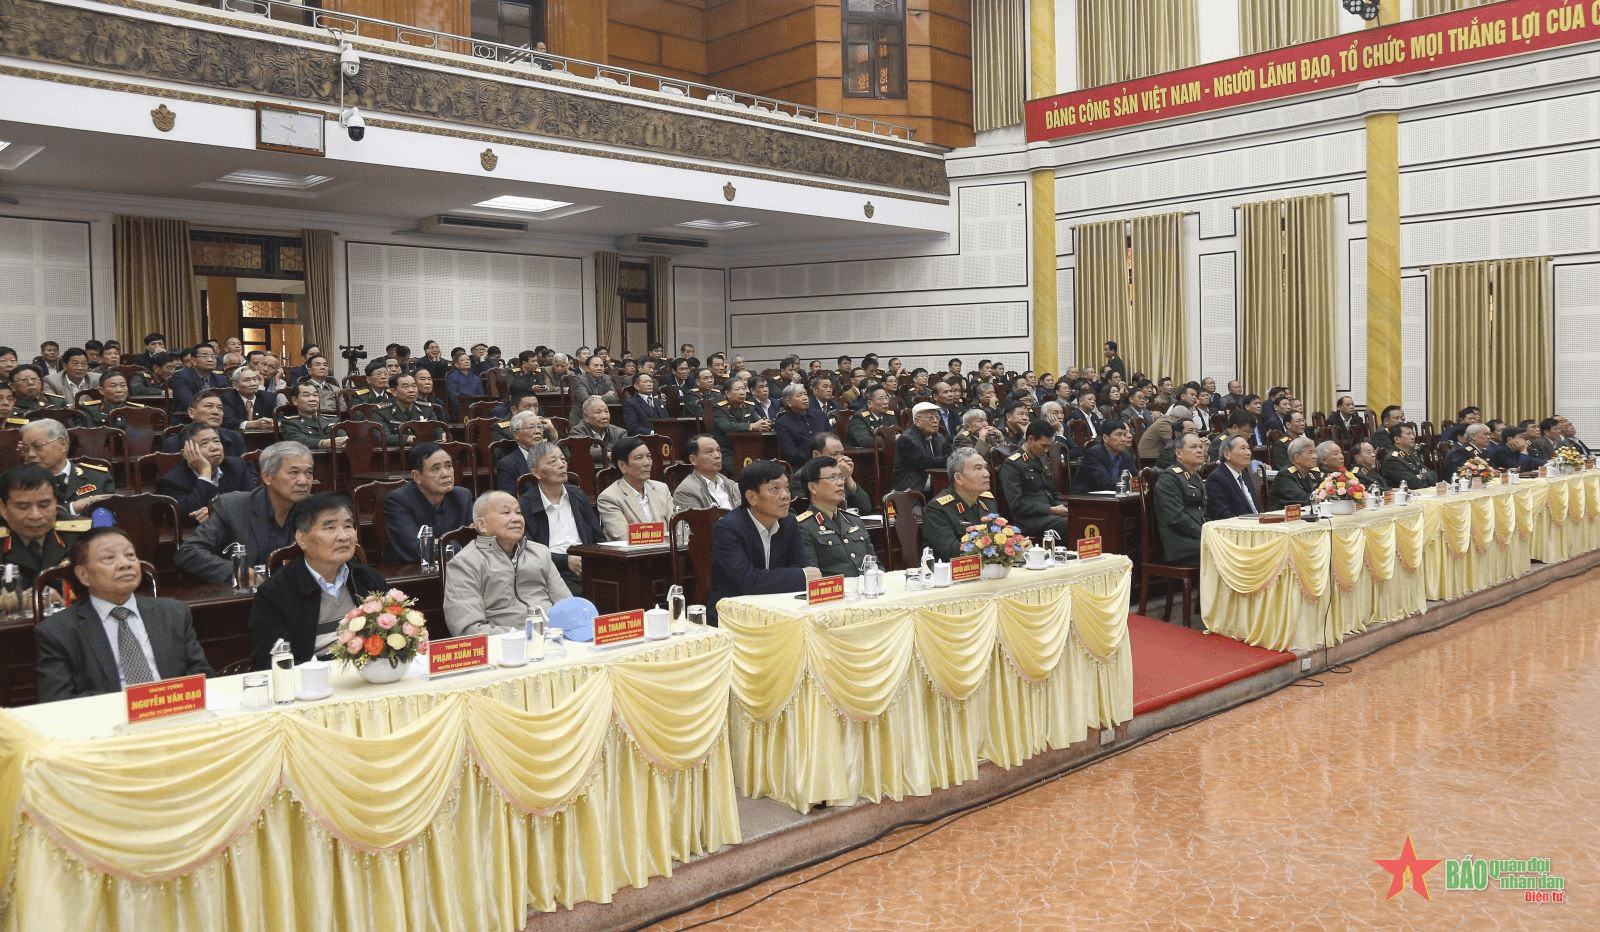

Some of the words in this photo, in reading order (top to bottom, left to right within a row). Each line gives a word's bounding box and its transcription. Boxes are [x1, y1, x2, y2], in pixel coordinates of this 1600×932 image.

[1045, 101, 1076, 129] ĐẢNG
[1078, 98, 1111, 126] CỘNG
[1113, 87, 1139, 117] SẢN
[1141, 85, 1167, 114] VIỆT
[1170, 81, 1201, 106] NAM
[1213, 66, 1256, 97] NGƯỜI
[1259, 61, 1297, 89] LÃNH
[1301, 54, 1336, 83] ĐẠO,
[1339, 39, 1358, 73] TỔ
[1362, 35, 1406, 69] CHỨC
[1410, 31, 1443, 62] MỌI
[1447, 16, 1506, 53] THẮNG
[1511, 11, 1540, 44] LỢI
[432, 652, 452, 663] PHẠM
[453, 649, 472, 660] XUÂN
